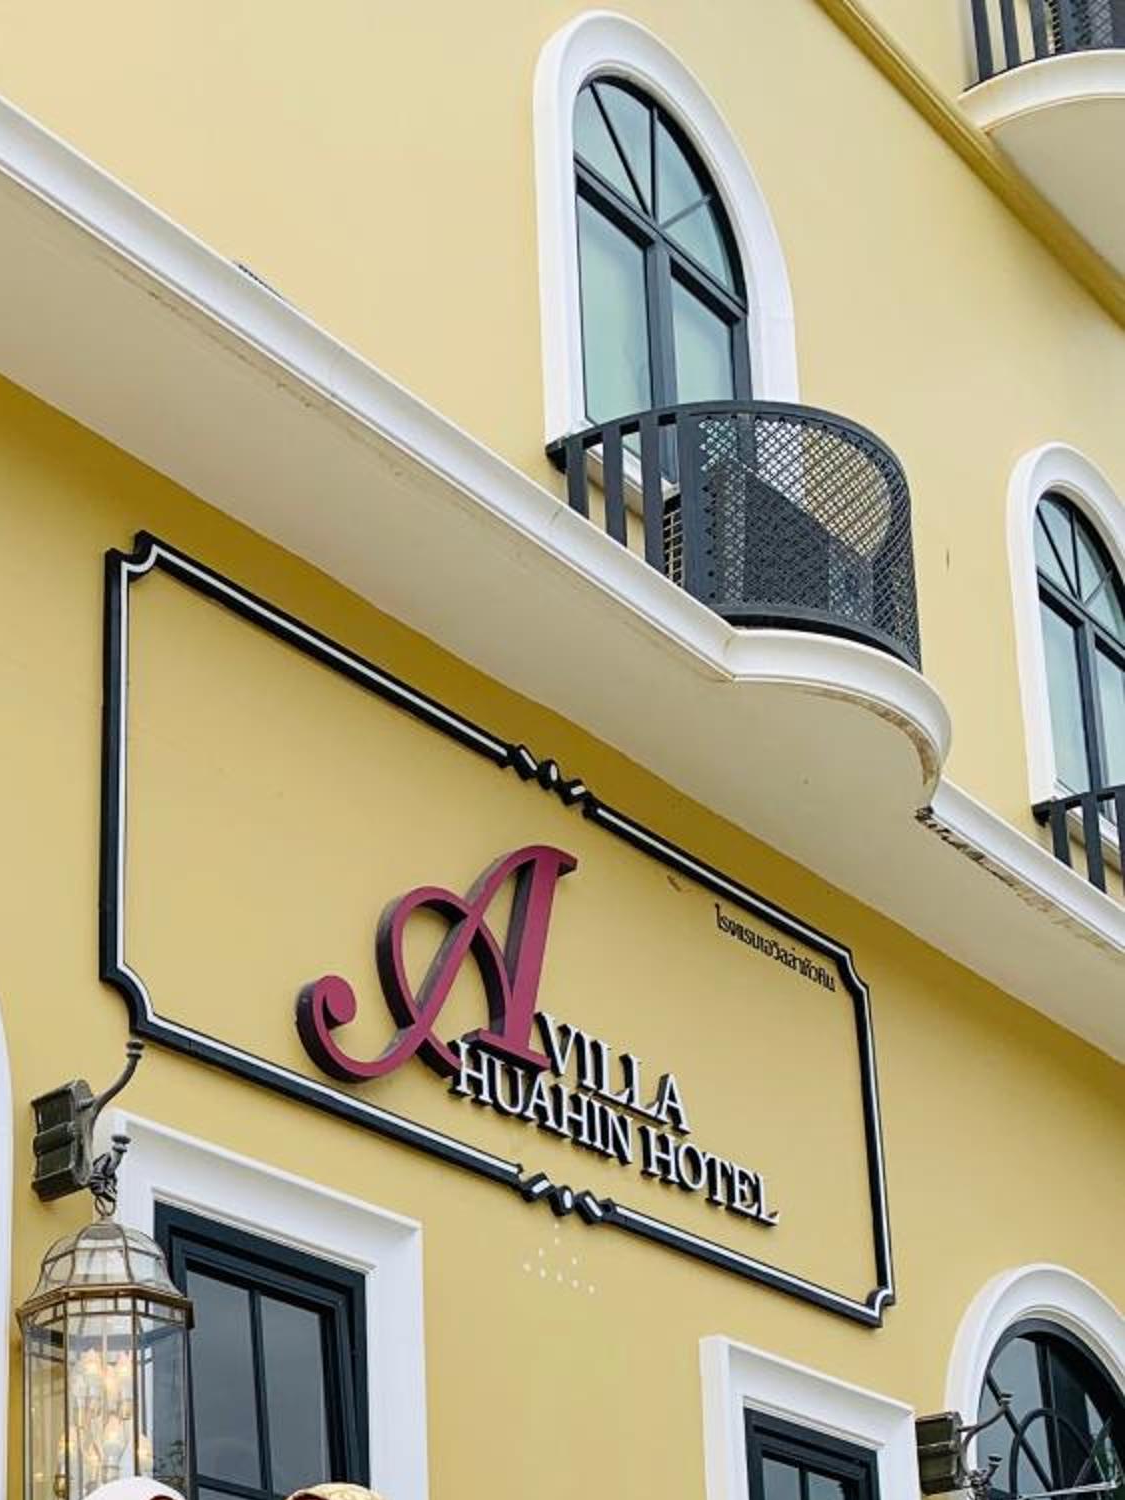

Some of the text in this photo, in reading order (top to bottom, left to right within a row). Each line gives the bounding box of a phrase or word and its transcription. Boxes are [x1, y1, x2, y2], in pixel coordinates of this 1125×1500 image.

[297, 844, 690, 1134] A VILLA
[448, 1039, 780, 1226] HUAHIN HOTEL
